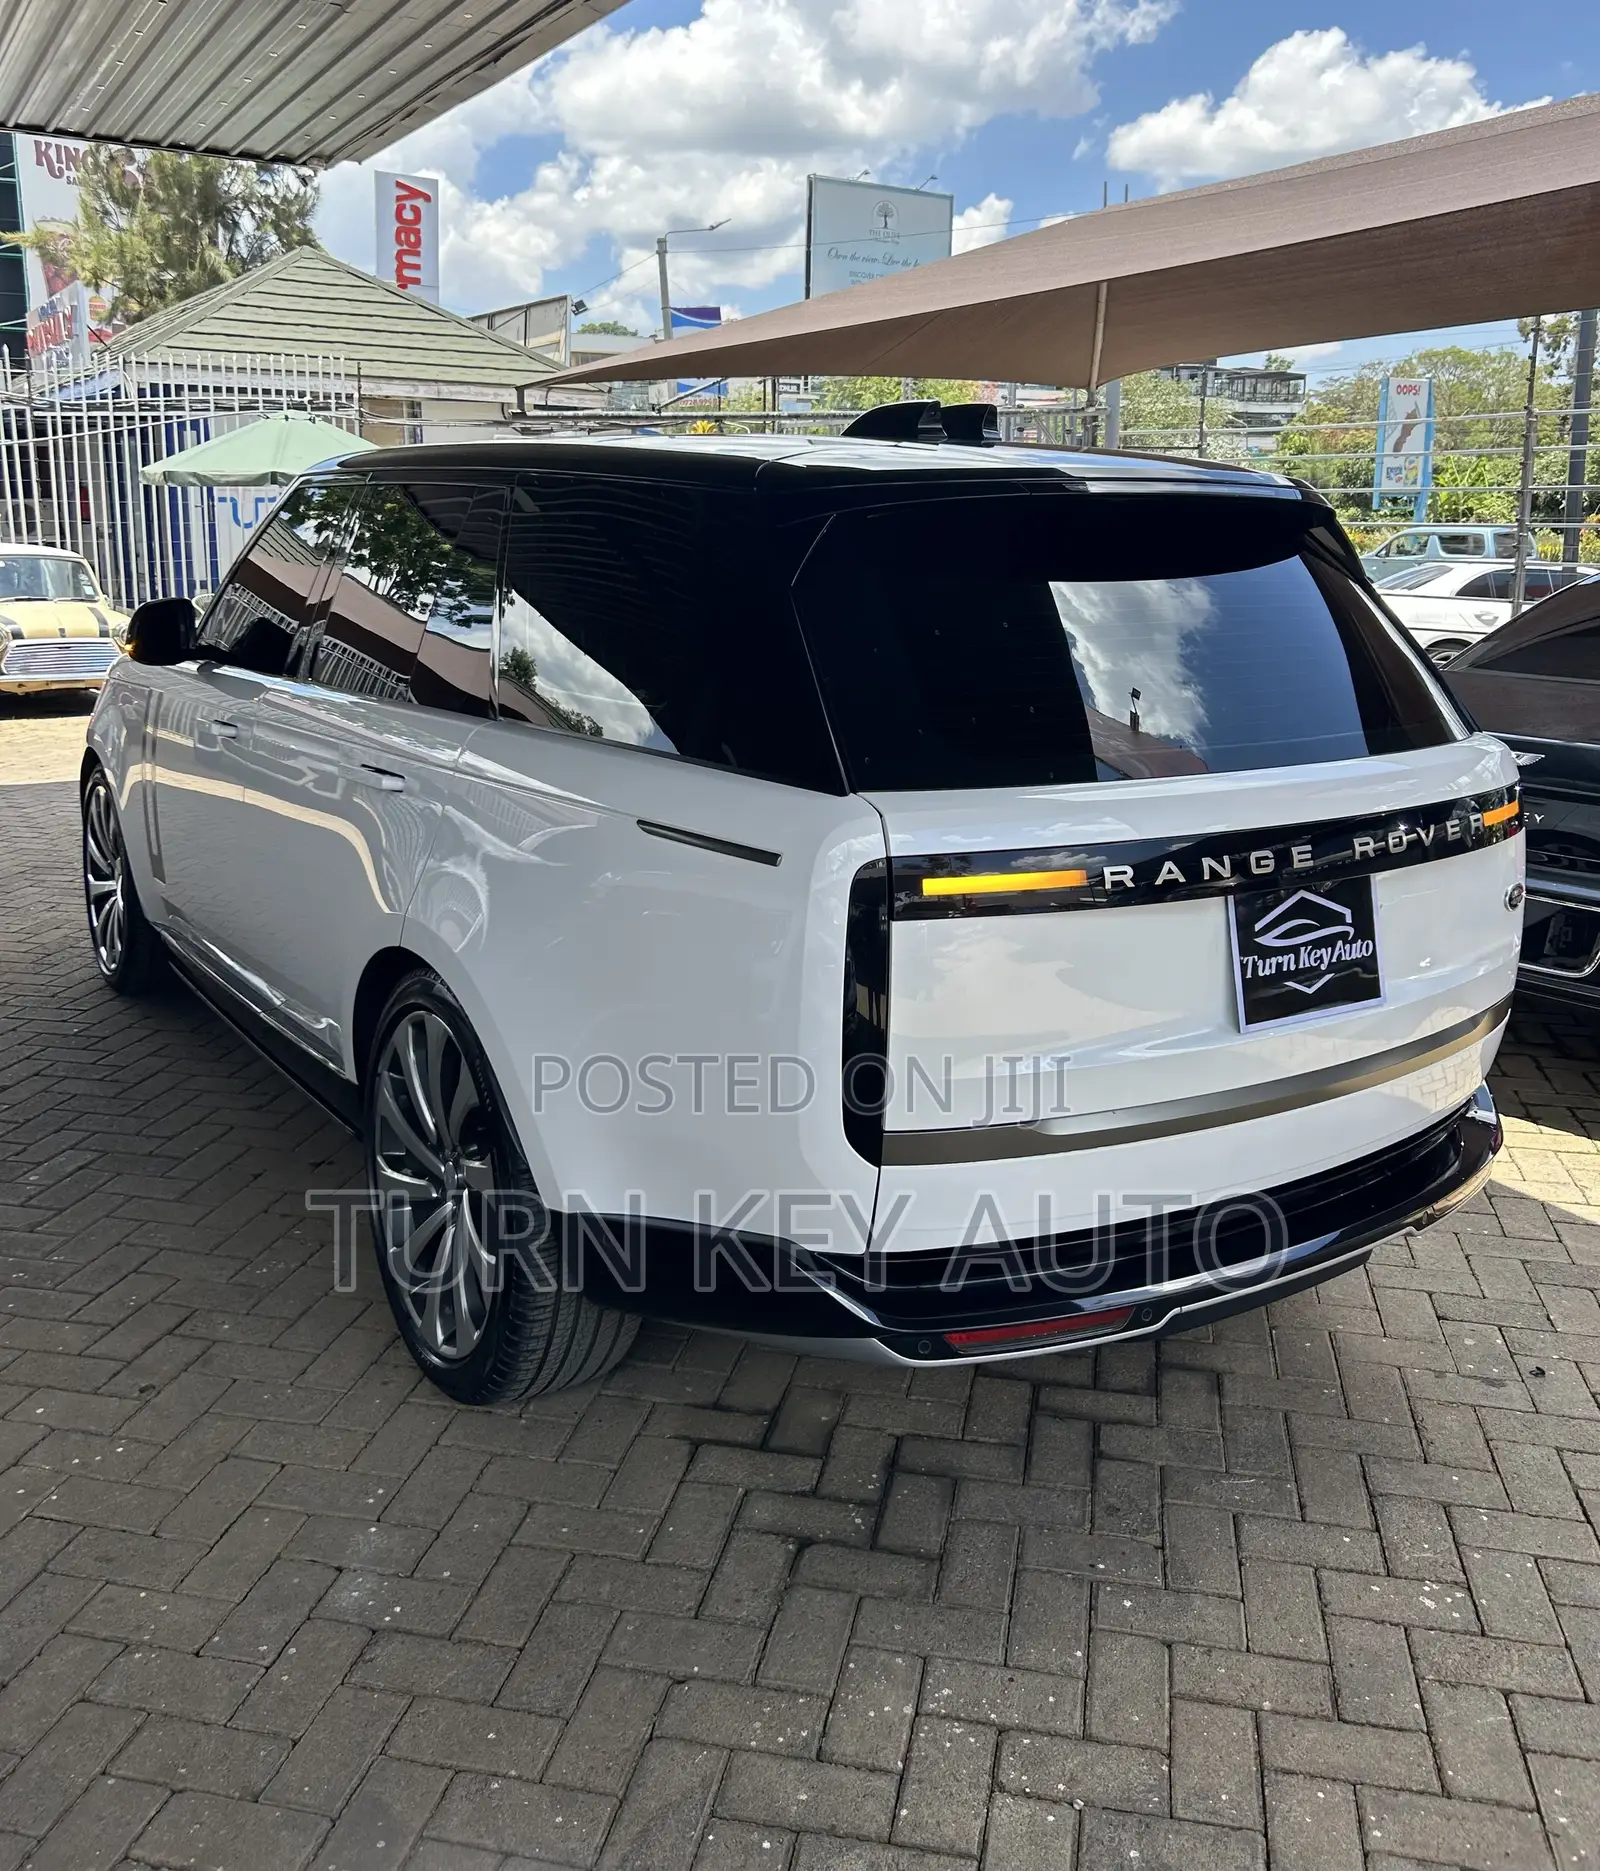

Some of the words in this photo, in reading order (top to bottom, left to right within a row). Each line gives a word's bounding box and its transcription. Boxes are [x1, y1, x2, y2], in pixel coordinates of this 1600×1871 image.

[827, 246, 848, 260] Own
[849, 251, 861, 262] the
[1396, 384, 1421, 396] OOPS!
[1102, 844, 1315, 890] RANGE
[1353, 812, 1485, 861] ROVER
[1240, 952, 1297, 979] Turn
[1298, 945, 1332, 971] Key
[1331, 939, 1374, 963] Auto
